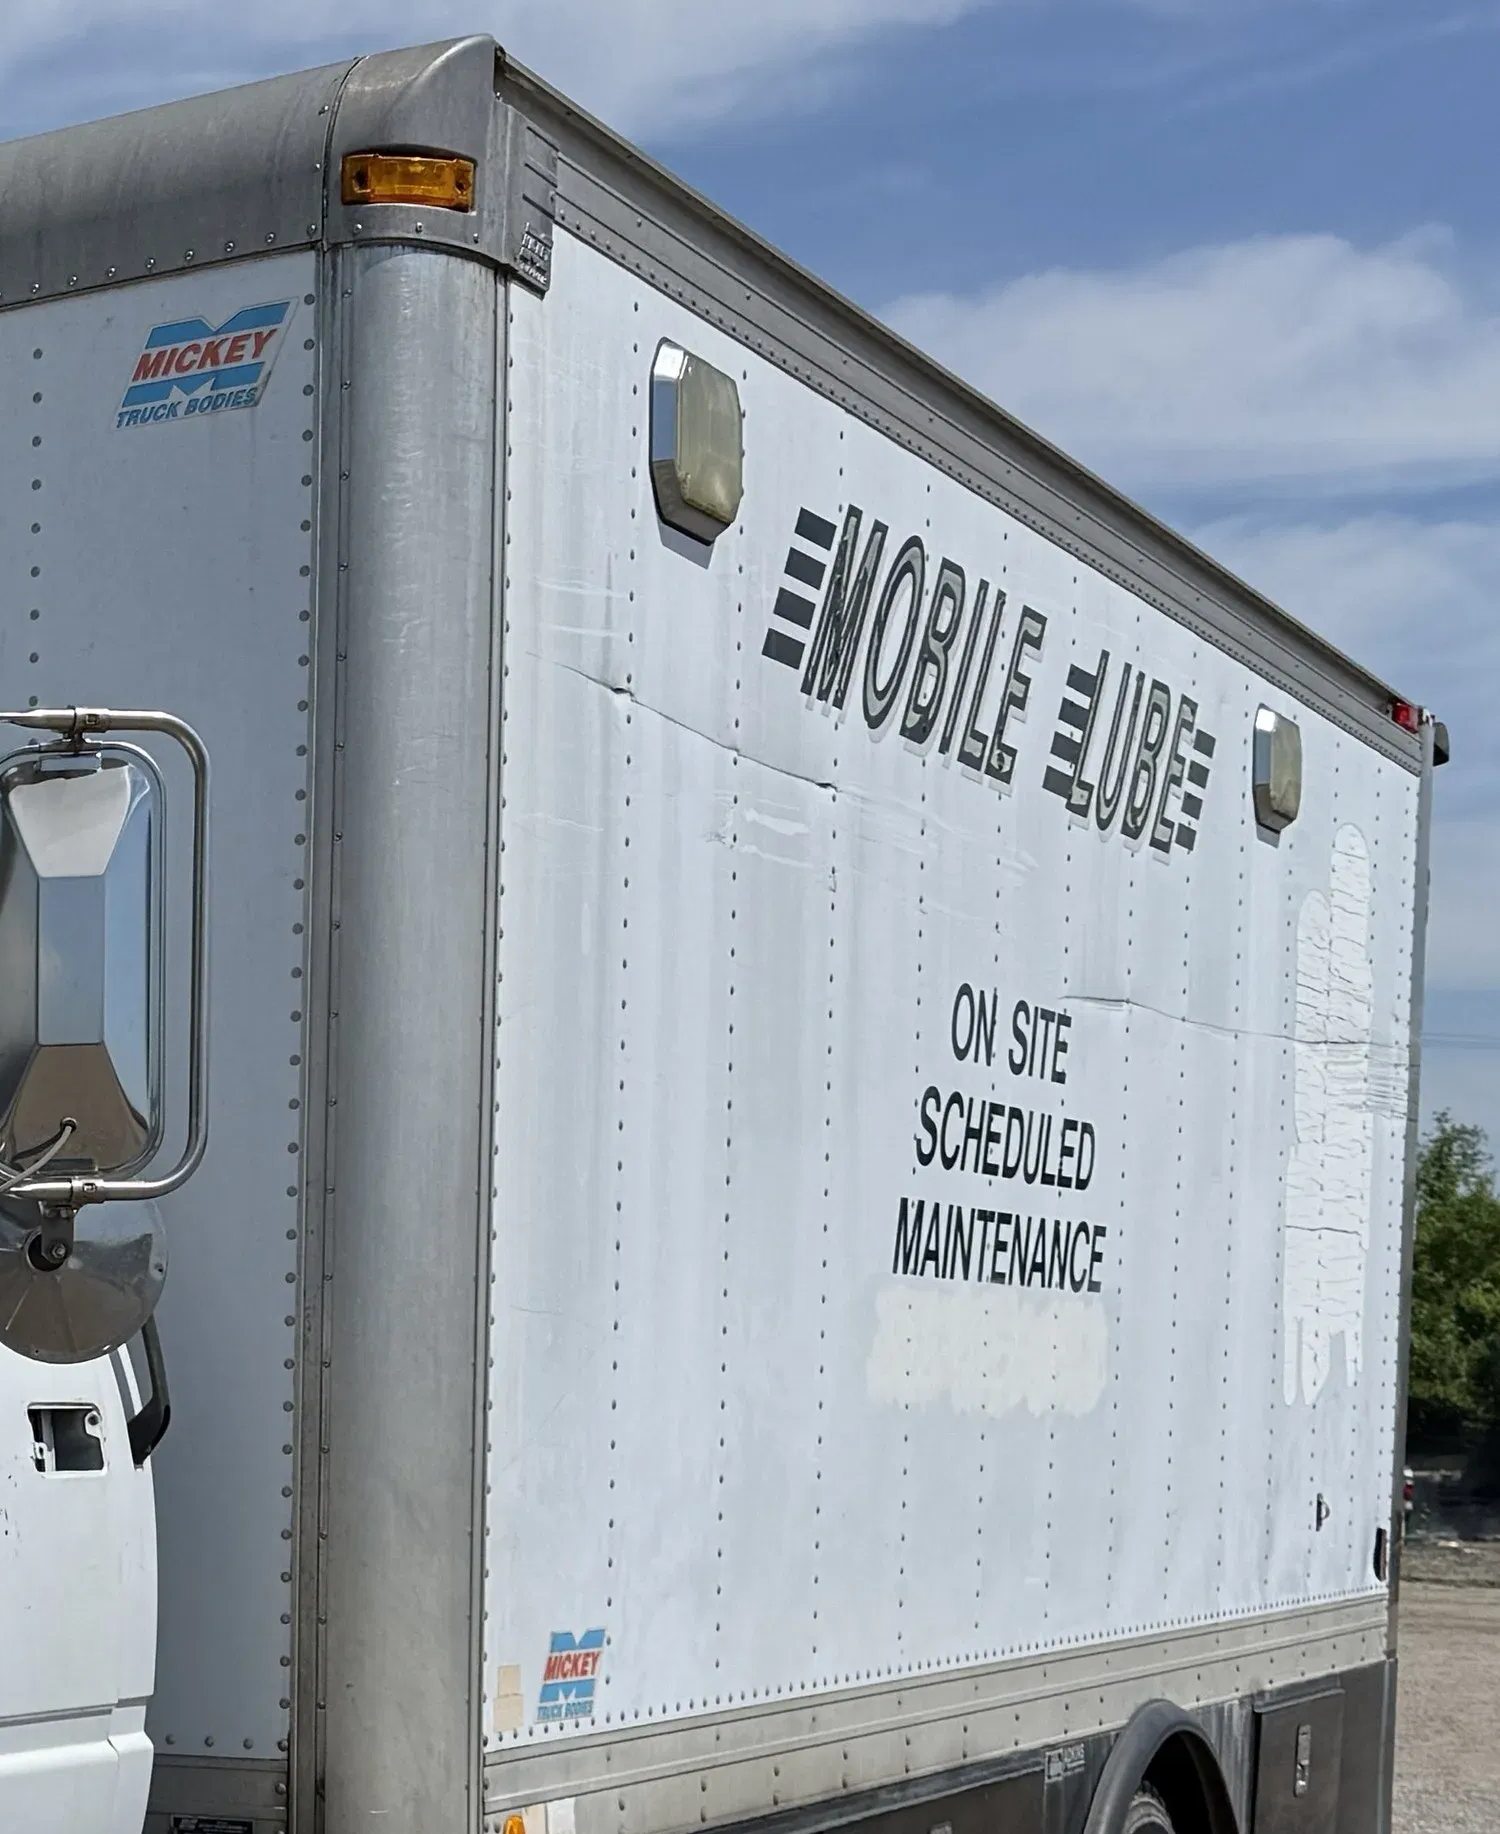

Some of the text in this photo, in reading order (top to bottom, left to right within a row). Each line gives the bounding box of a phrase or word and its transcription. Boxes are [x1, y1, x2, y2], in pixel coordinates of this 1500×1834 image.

[132, 328, 278, 382] MICKEY
[116, 387, 258, 428] TRUCK BODIES
[800, 504, 1198, 854] MOBILE LUBE
[951, 983, 1072, 1085] ON SITE
[915, 1086, 1096, 1192] SCHEDULED
[892, 1197, 1107, 1294] MAINTENANCE
[543, 1650, 601, 1682] MICKEY
